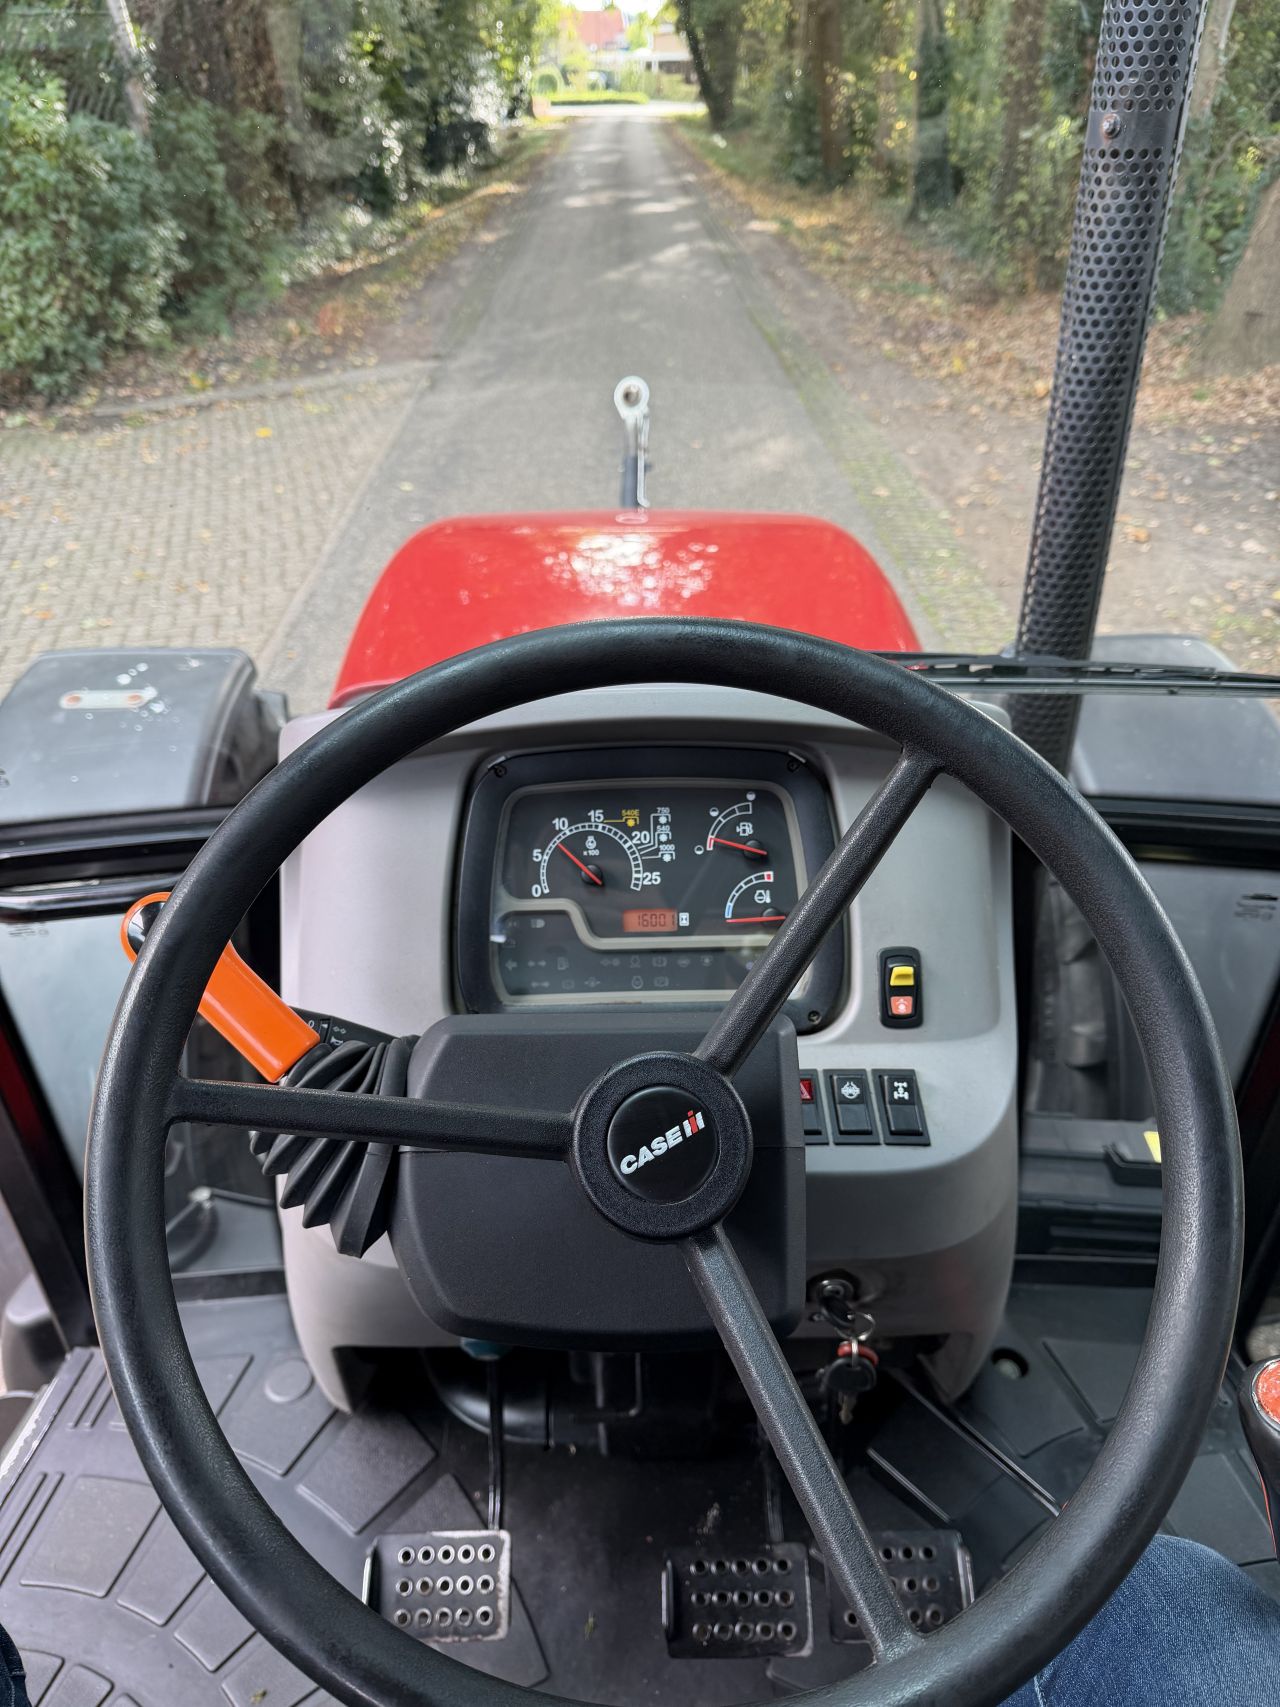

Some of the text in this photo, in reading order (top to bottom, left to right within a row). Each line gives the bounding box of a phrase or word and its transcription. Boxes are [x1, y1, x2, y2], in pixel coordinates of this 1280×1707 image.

[588, 809, 604, 822] 15
[552, 818, 568, 831] 10
[631, 831, 650, 844] 20
[532, 849, 542, 862] 5
[642, 871, 661, 885] 25
[531, 884, 542, 897] 0
[620, 1125, 684, 1175] CASE
